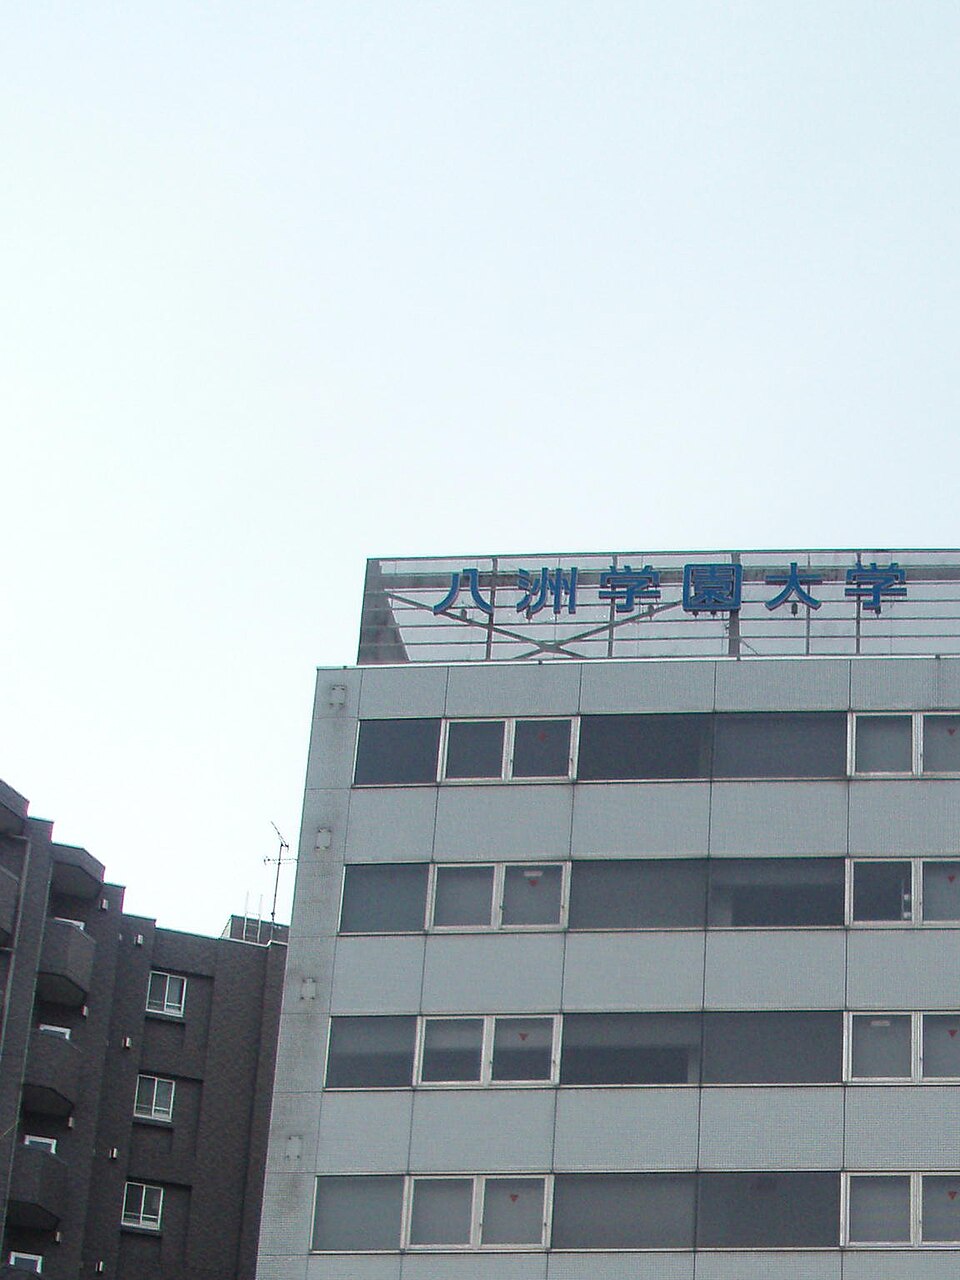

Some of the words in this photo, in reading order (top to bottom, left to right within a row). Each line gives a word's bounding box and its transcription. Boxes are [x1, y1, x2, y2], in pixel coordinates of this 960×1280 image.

[433, 562, 908, 615] 八洲学園大学
